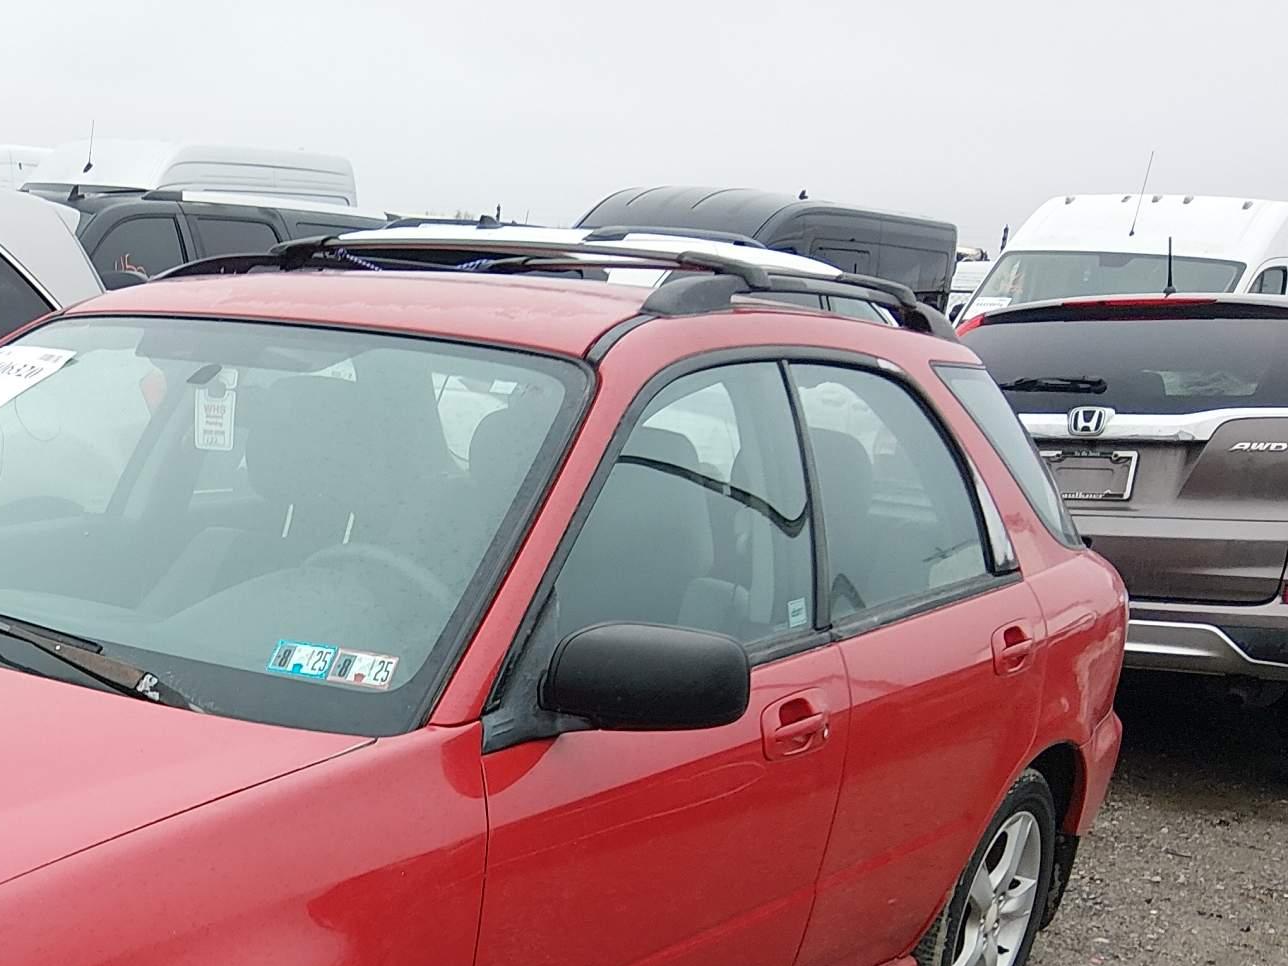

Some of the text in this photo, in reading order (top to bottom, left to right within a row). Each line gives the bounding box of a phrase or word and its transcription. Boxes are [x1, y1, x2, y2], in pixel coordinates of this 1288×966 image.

[1228, 441, 1288, 452] AWD
[310, 650, 331, 672] 25
[372, 660, 393, 683] 25
